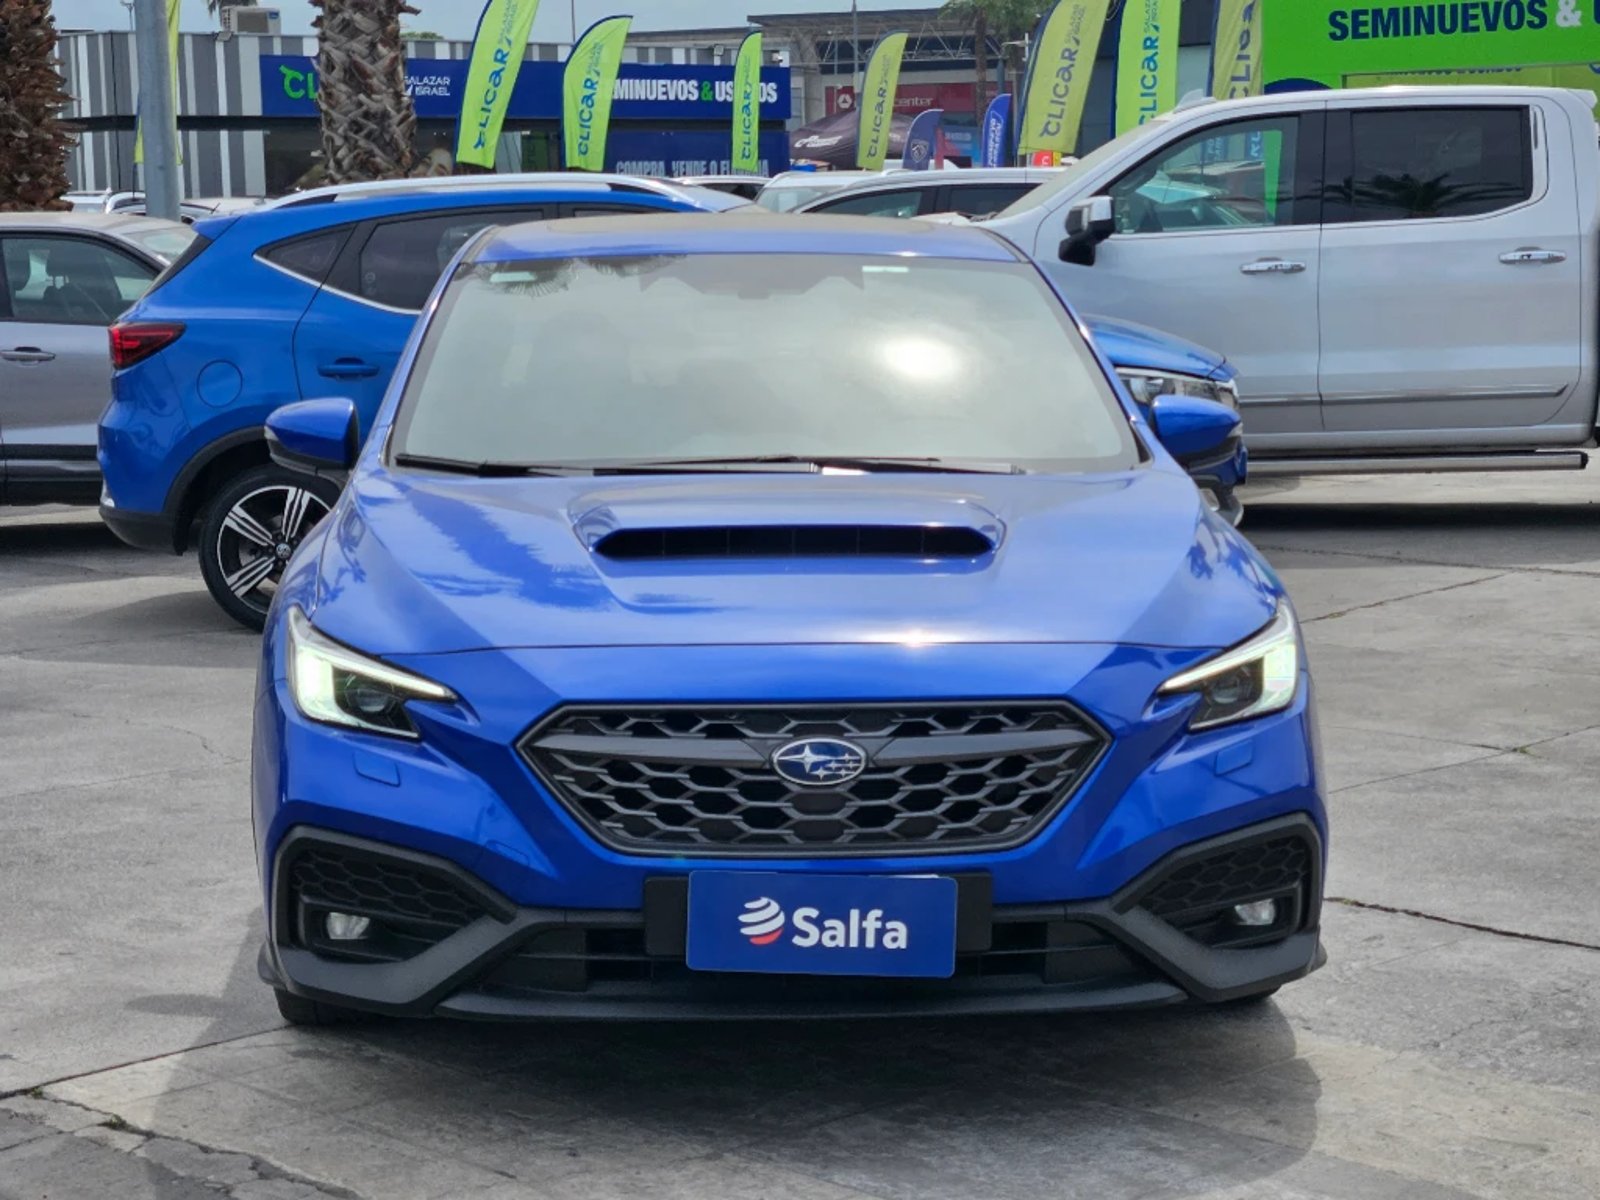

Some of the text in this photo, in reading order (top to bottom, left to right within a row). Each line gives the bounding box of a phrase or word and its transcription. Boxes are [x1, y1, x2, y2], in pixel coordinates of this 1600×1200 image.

[1328, 0, 1548, 41] SEMINUEVOS
[1555, 0, 1582, 27] &
[700, 80, 714, 101] &
[791, 906, 908, 949] Salfa
